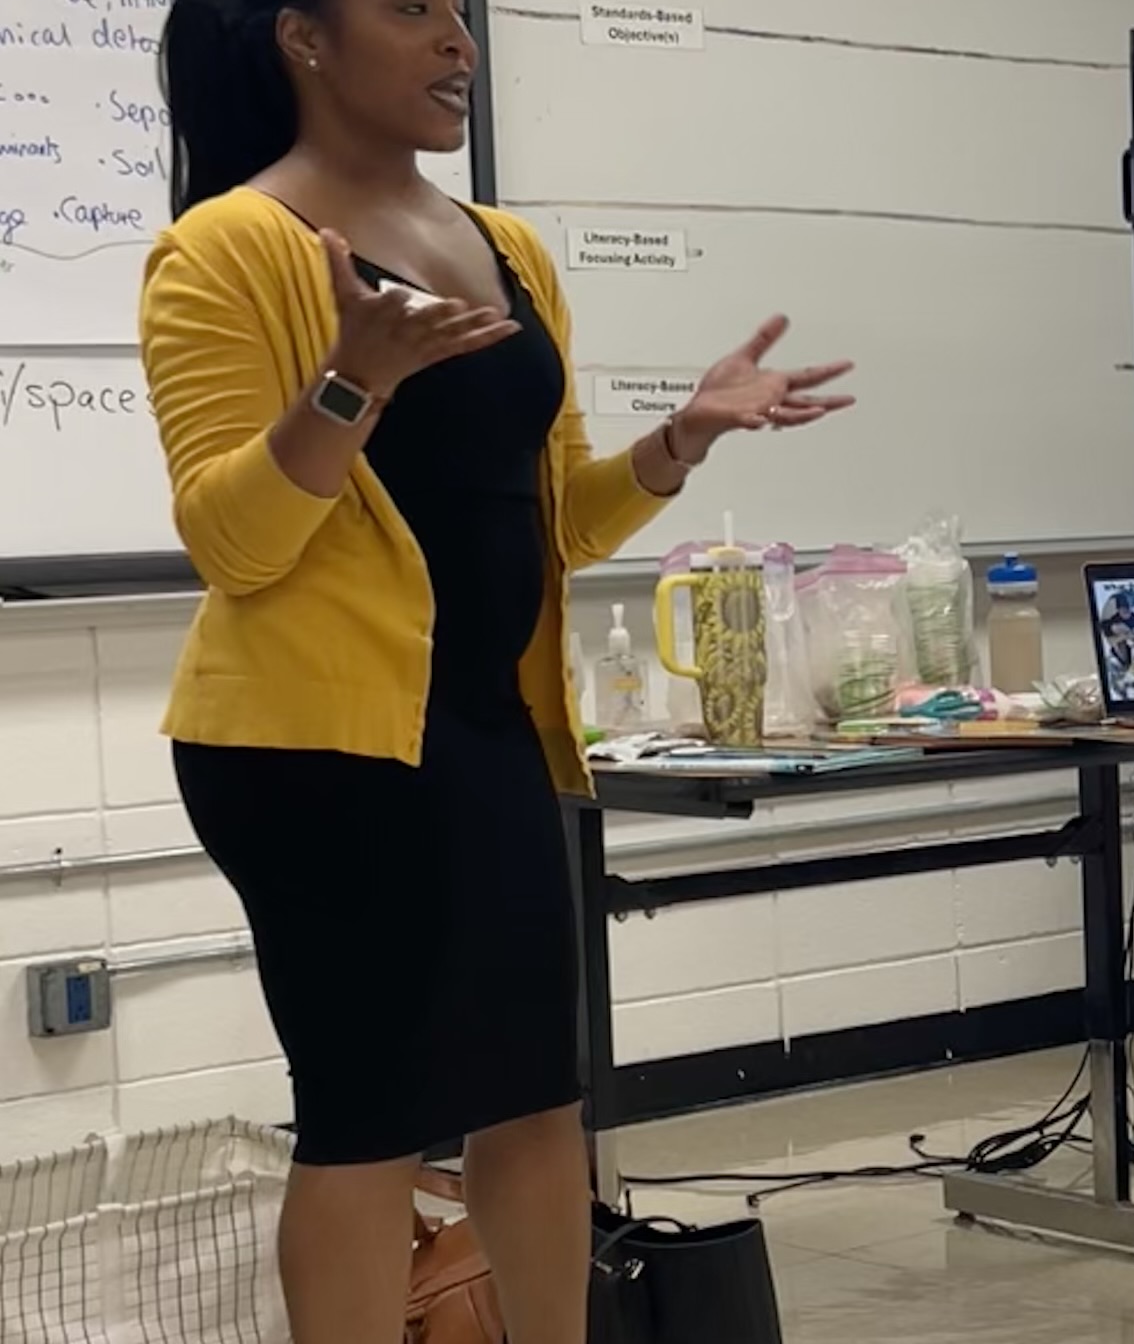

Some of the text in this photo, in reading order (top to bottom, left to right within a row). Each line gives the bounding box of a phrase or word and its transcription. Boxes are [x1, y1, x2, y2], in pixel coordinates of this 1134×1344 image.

[592, 5, 693, 25] Standards-Based
[579, 251, 675, 268] Focusing Activity
